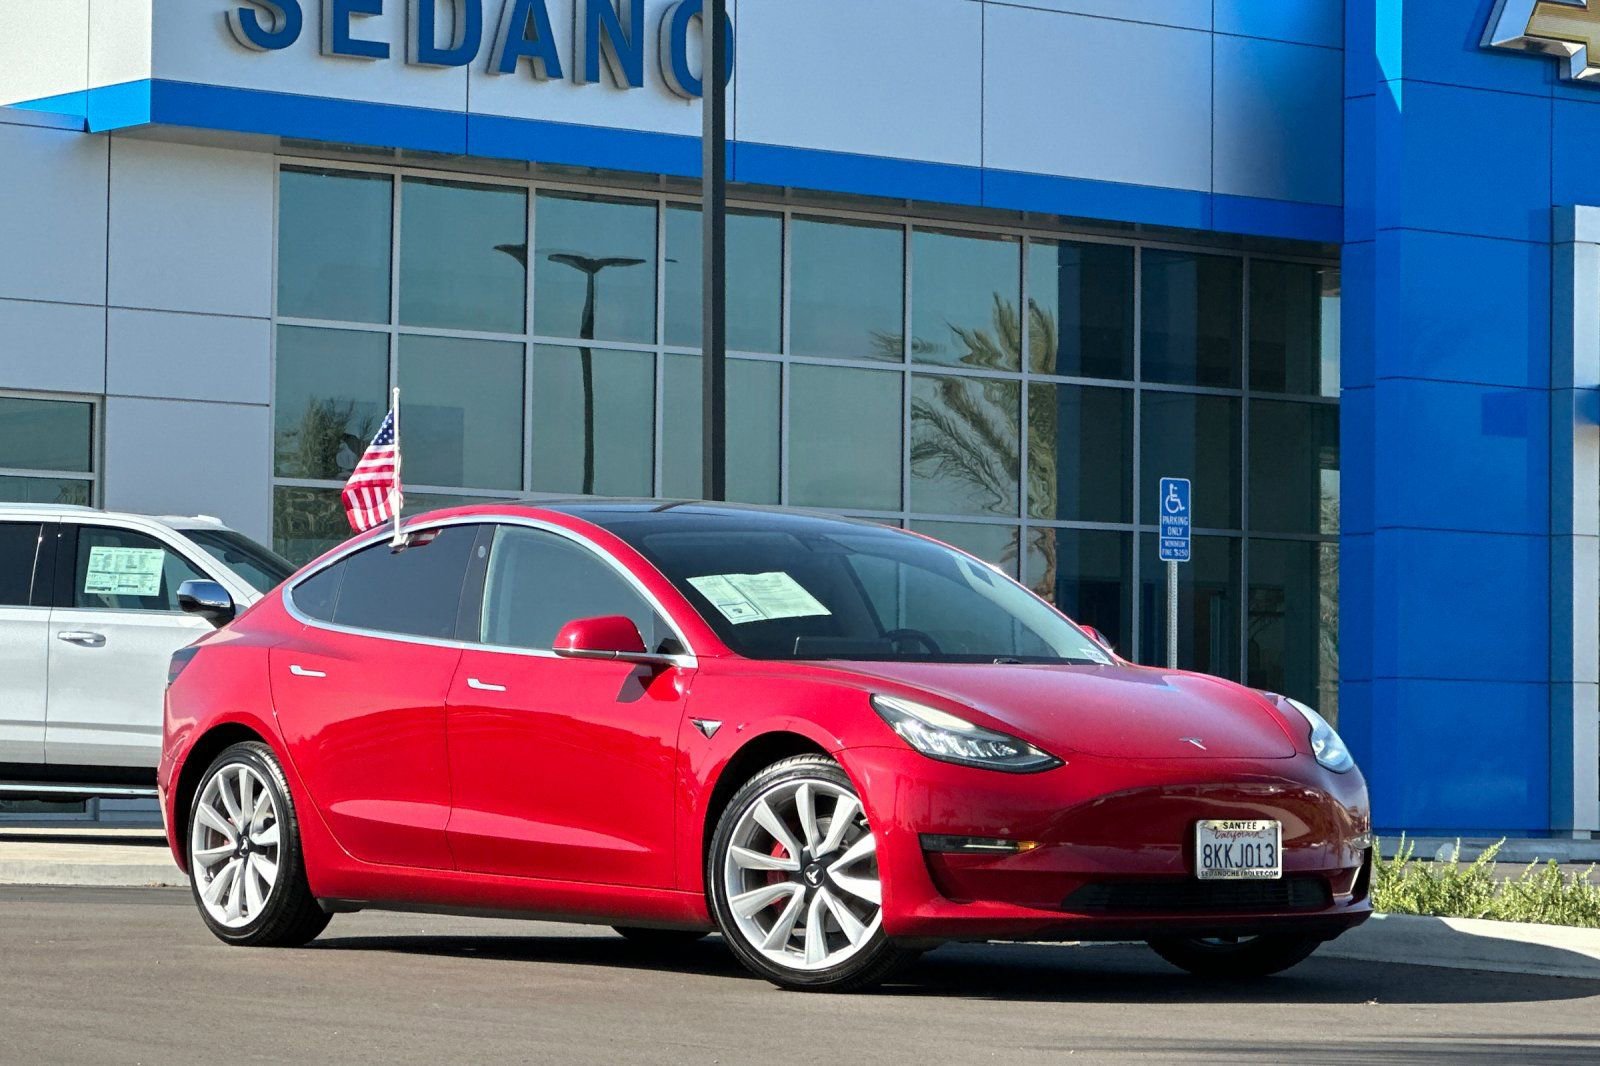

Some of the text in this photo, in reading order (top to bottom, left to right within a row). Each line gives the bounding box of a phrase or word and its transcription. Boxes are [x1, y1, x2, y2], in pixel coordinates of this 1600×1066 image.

[1162, 516, 1188, 526] PARKING
[1168, 526, 1182, 536] ONLY
[1174, 548, 1188, 556] $250
[1223, 822, 1257, 830] SANTEE
[1214, 830, 1264, 842] California
[1203, 844, 1274, 868] 8KKJ013
